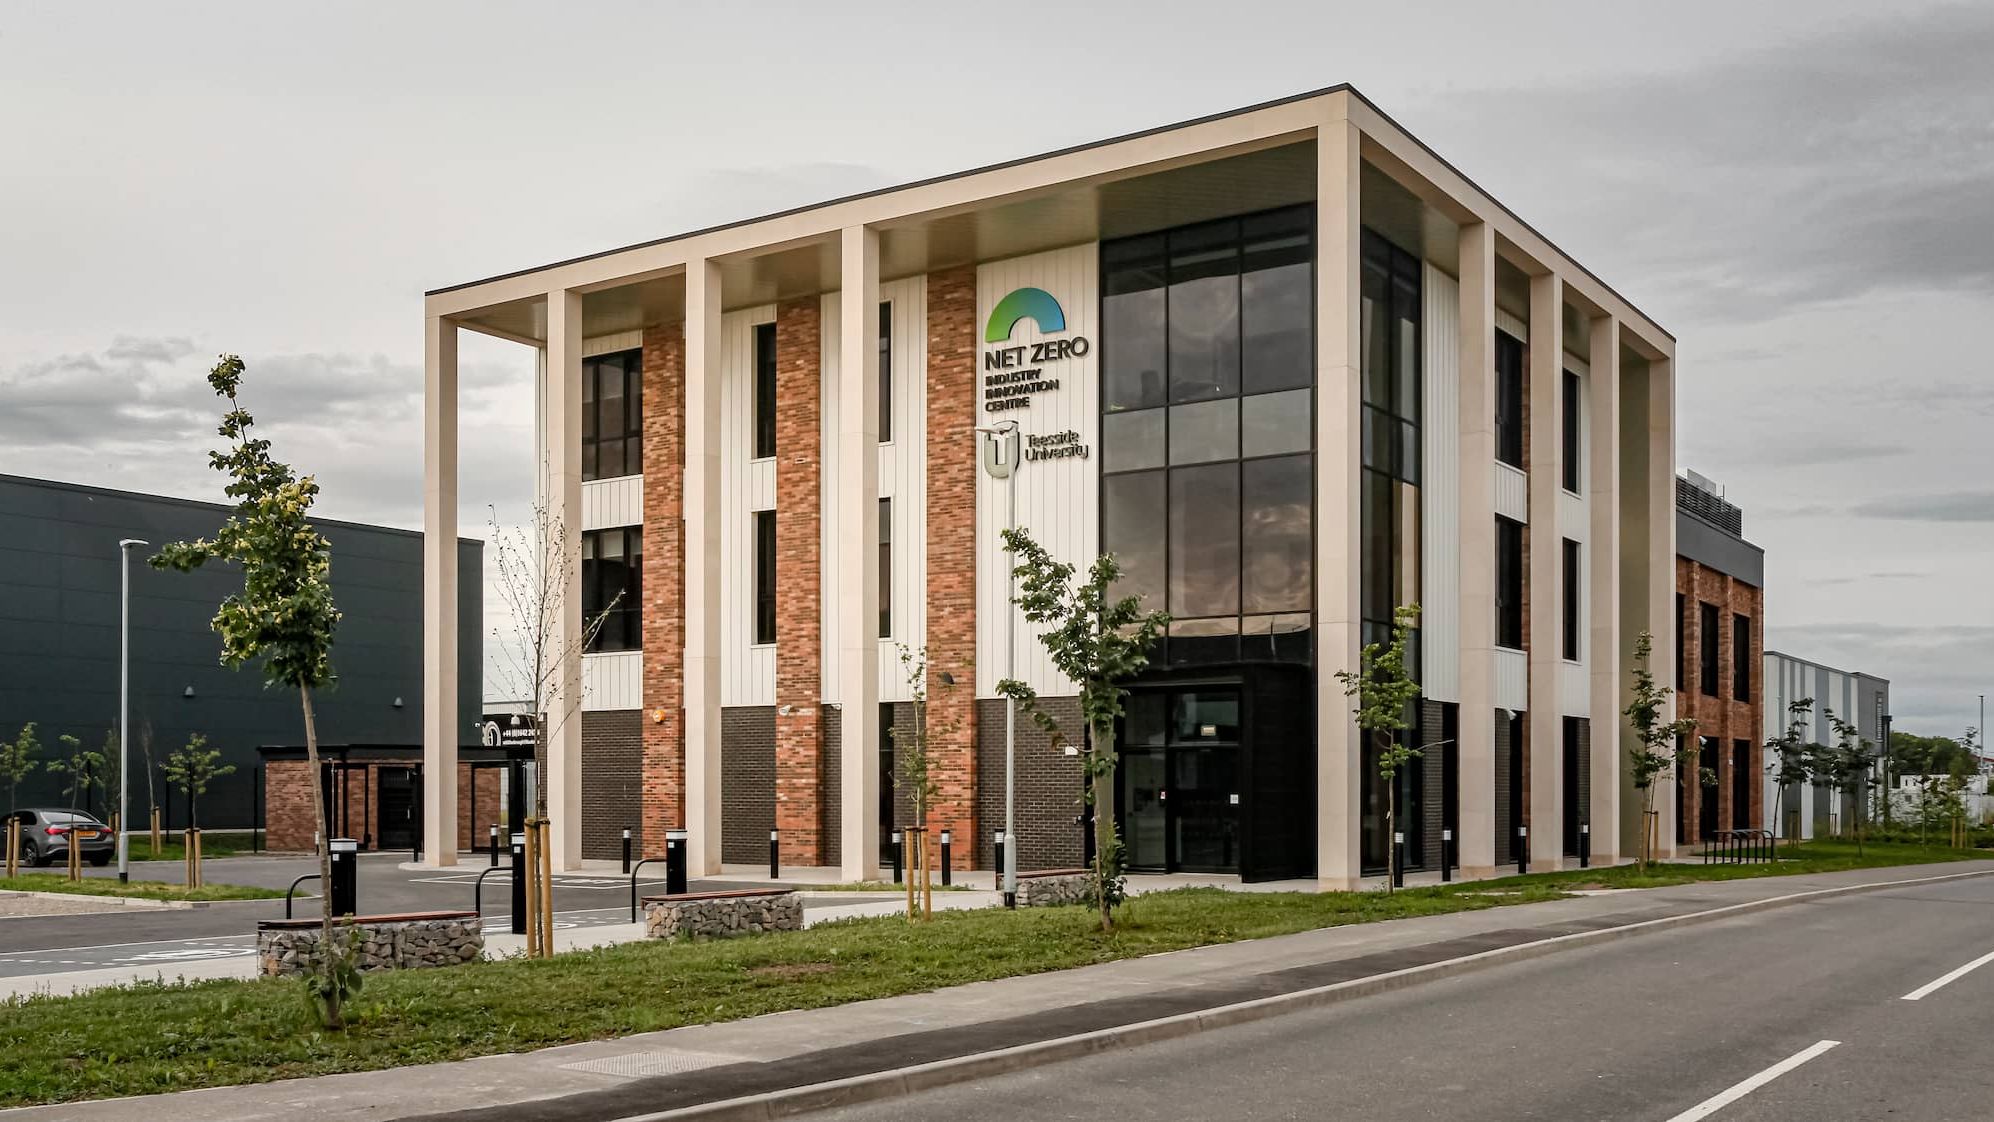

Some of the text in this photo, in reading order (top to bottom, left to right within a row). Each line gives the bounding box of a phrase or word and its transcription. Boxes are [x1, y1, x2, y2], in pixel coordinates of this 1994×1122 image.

[985, 336, 1089, 371] NET ZERO
[985, 368, 1042, 387] INDUSTRY
[985, 379, 1060, 400] INNOVATION
[985, 396, 1030, 412] CENTRE
[1025, 429, 1080, 448] Teesside
[1025, 443, 1089, 462] University
